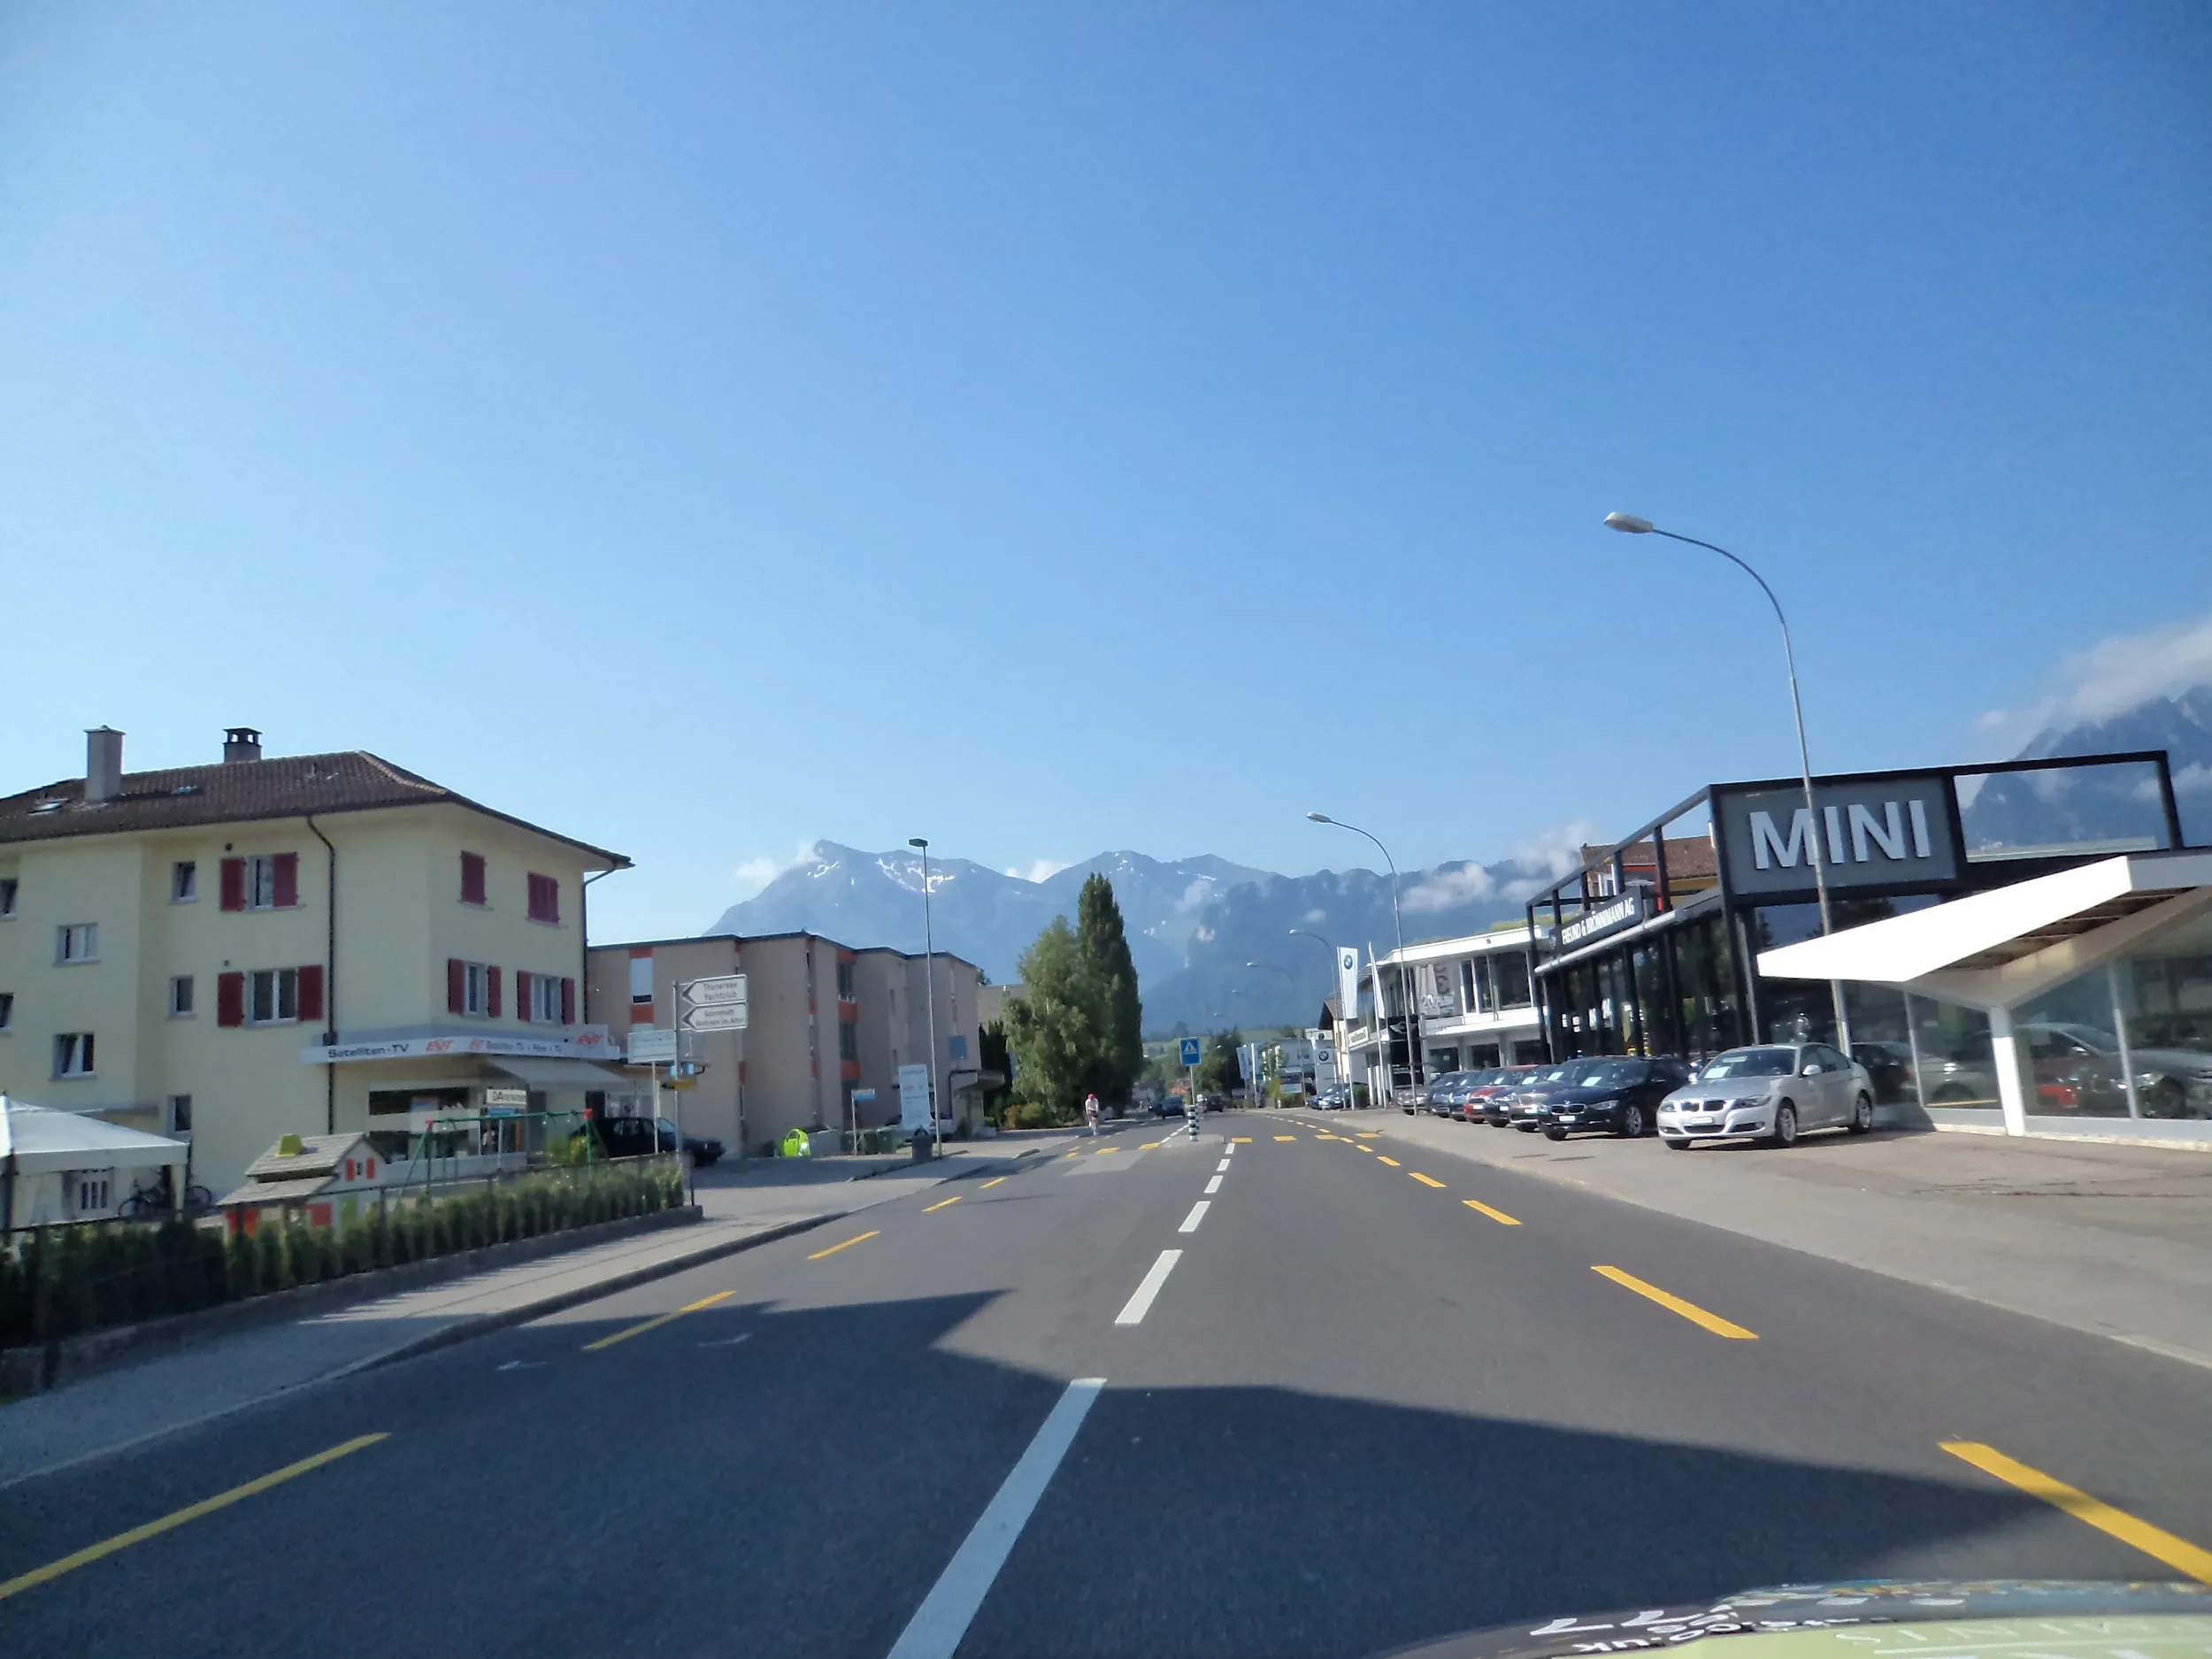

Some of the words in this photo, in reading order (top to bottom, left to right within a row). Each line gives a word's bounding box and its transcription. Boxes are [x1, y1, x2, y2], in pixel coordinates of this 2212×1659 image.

[1749, 800, 1931, 870] MINI
[1561, 923, 1581, 945] FREUND
[1580, 919, 1587, 937] &
[1624, 896, 1635, 918] AG
